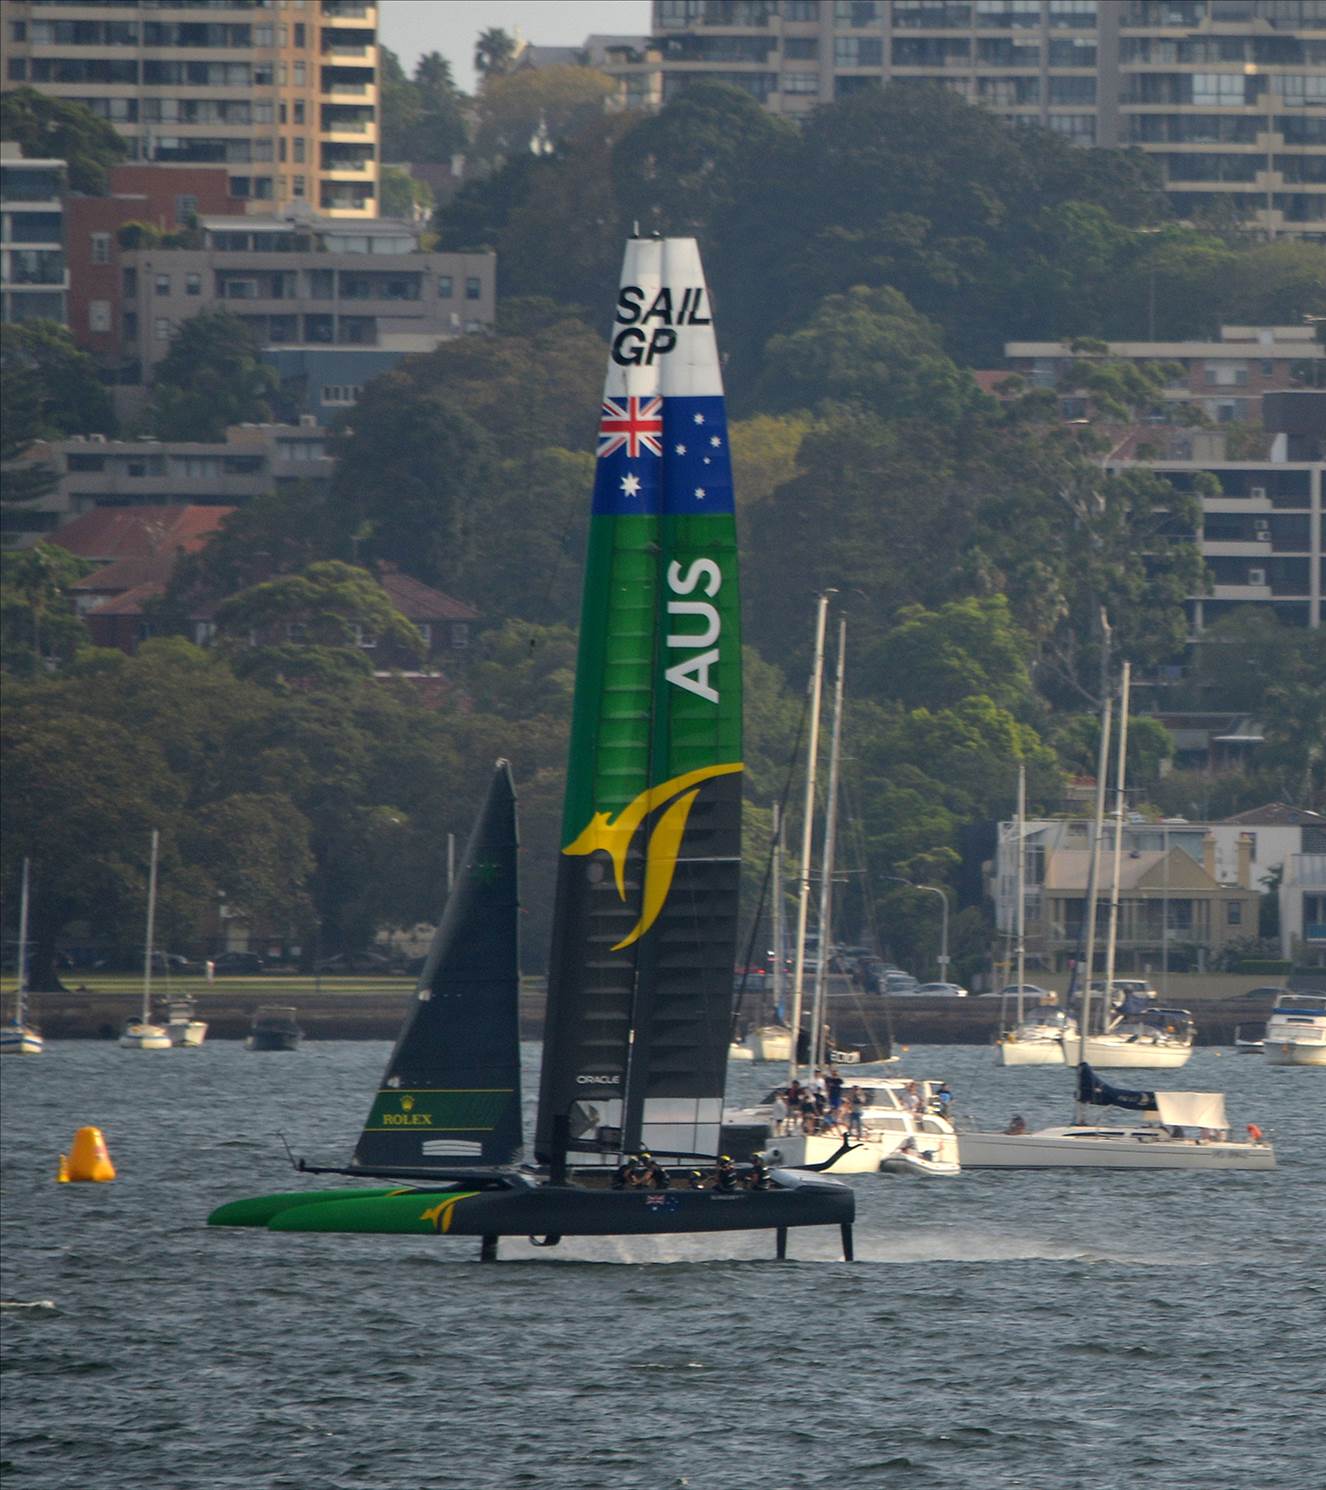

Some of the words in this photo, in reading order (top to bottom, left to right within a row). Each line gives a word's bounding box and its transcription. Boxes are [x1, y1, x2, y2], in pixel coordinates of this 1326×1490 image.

[615, 286, 711, 325] SAIL
[611, 327, 677, 366] GP
[665, 558, 721, 704] AUS
[576, 1075, 620, 1085] ORACLE
[383, 1114, 432, 1125] ROLEX
